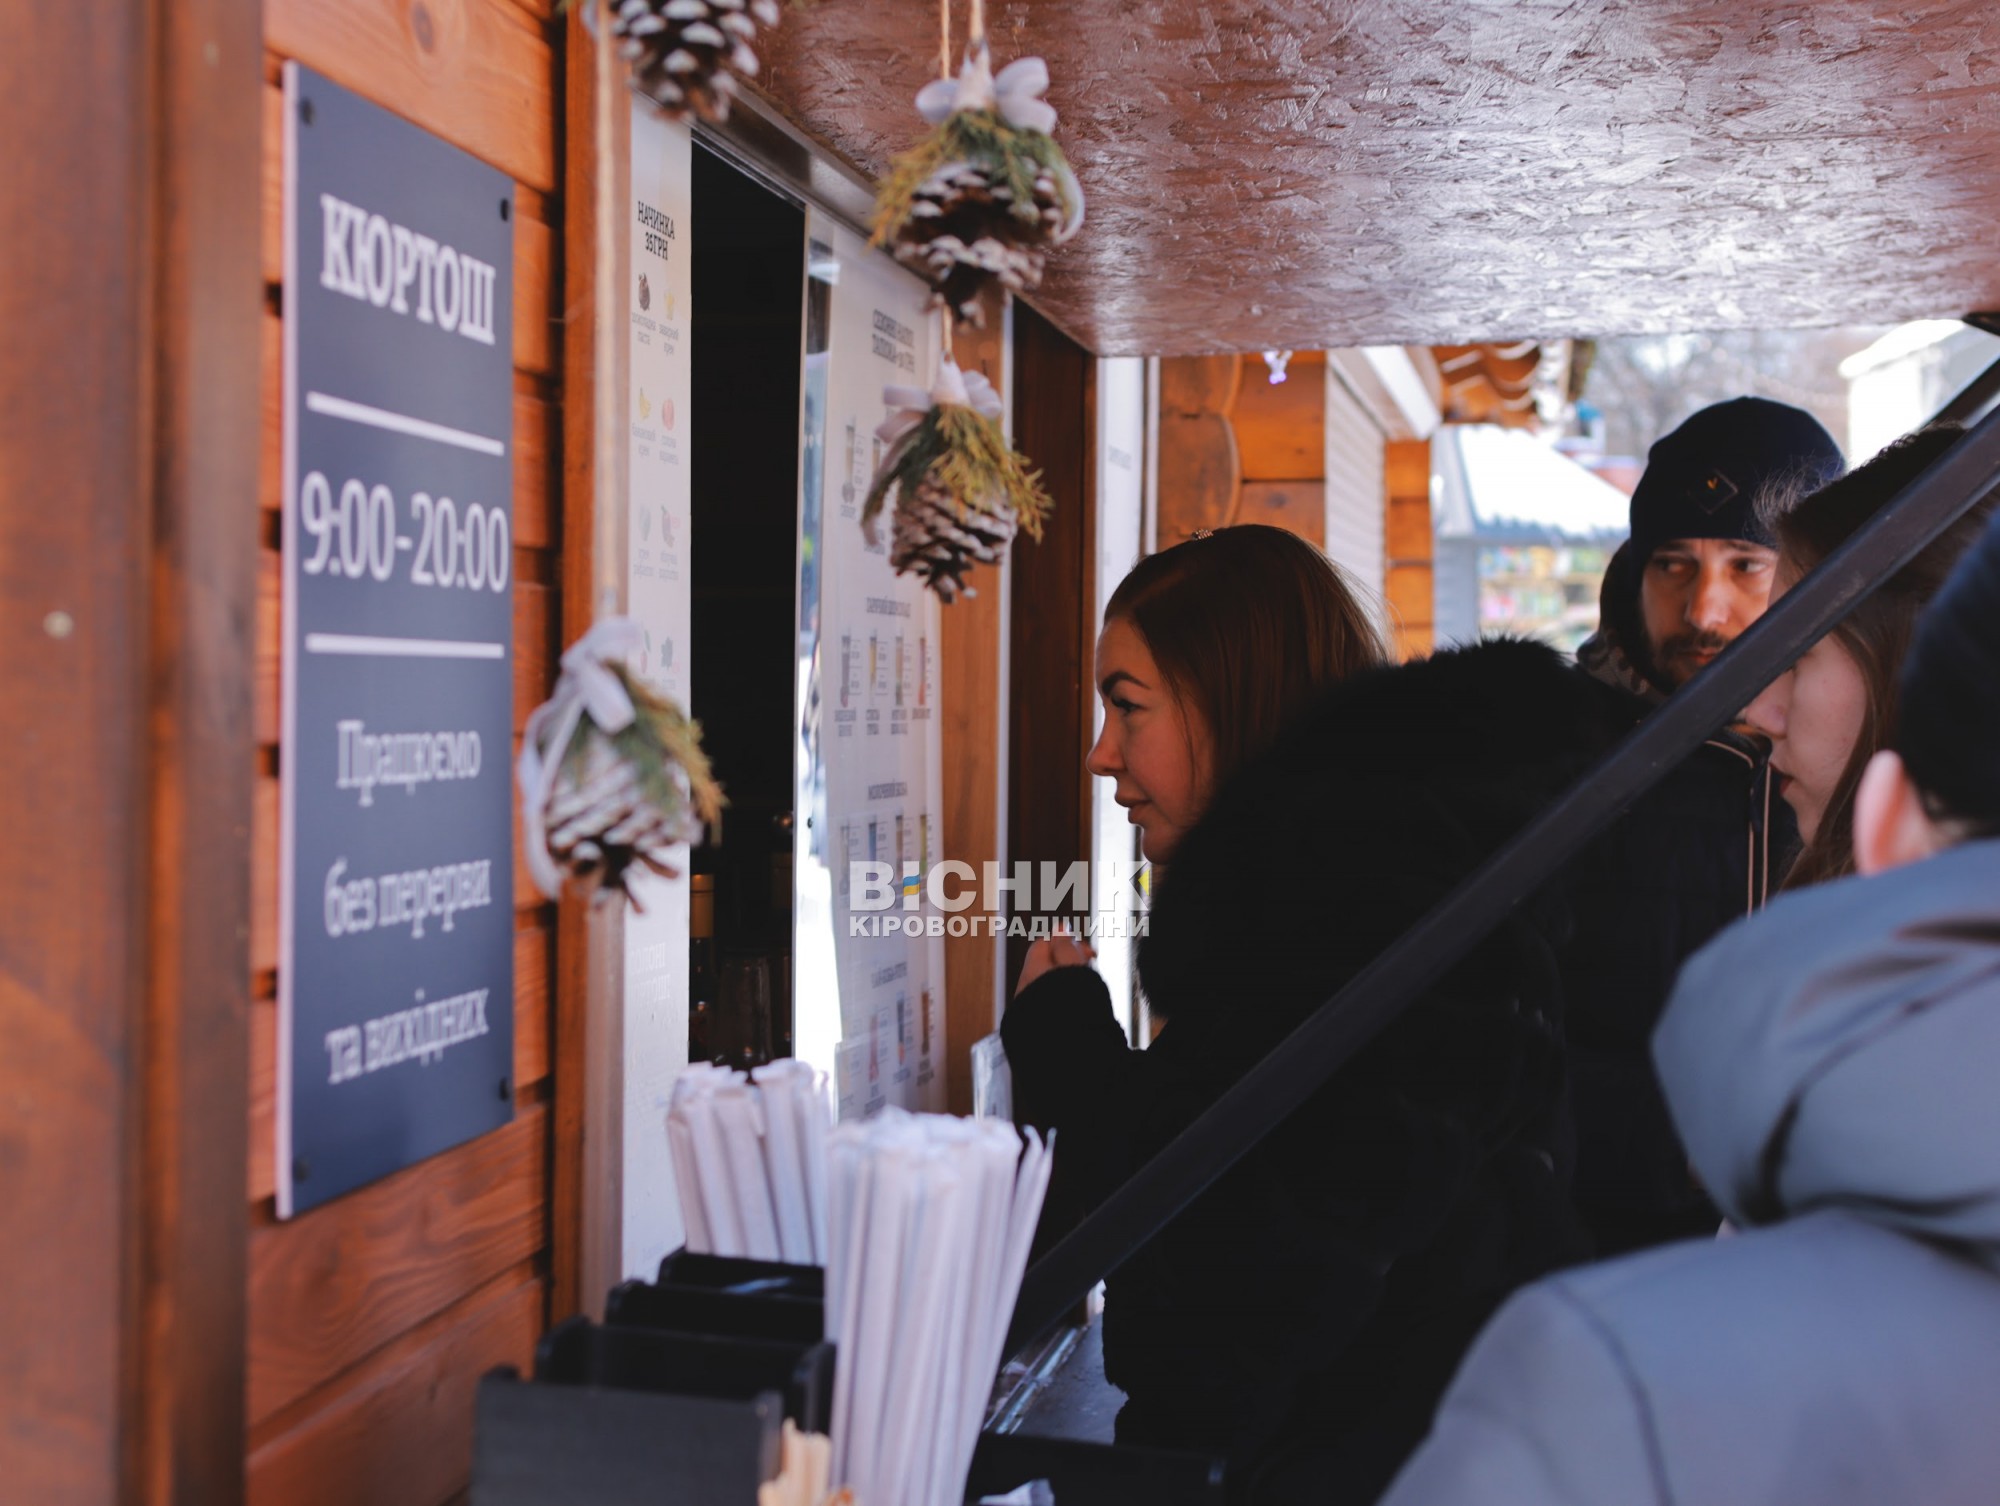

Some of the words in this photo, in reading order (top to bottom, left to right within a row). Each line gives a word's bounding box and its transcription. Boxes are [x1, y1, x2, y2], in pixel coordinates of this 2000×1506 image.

[637, 200, 675, 240] НАЧИНКА
[320, 193, 496, 345] КЮРТОШ
[336, 719, 482, 807] Працюємо
[324, 856, 377, 937] без
[378, 859, 492, 938] перерви
[325, 1024, 363, 1085] та
[365, 987, 489, 1073] вихідних
